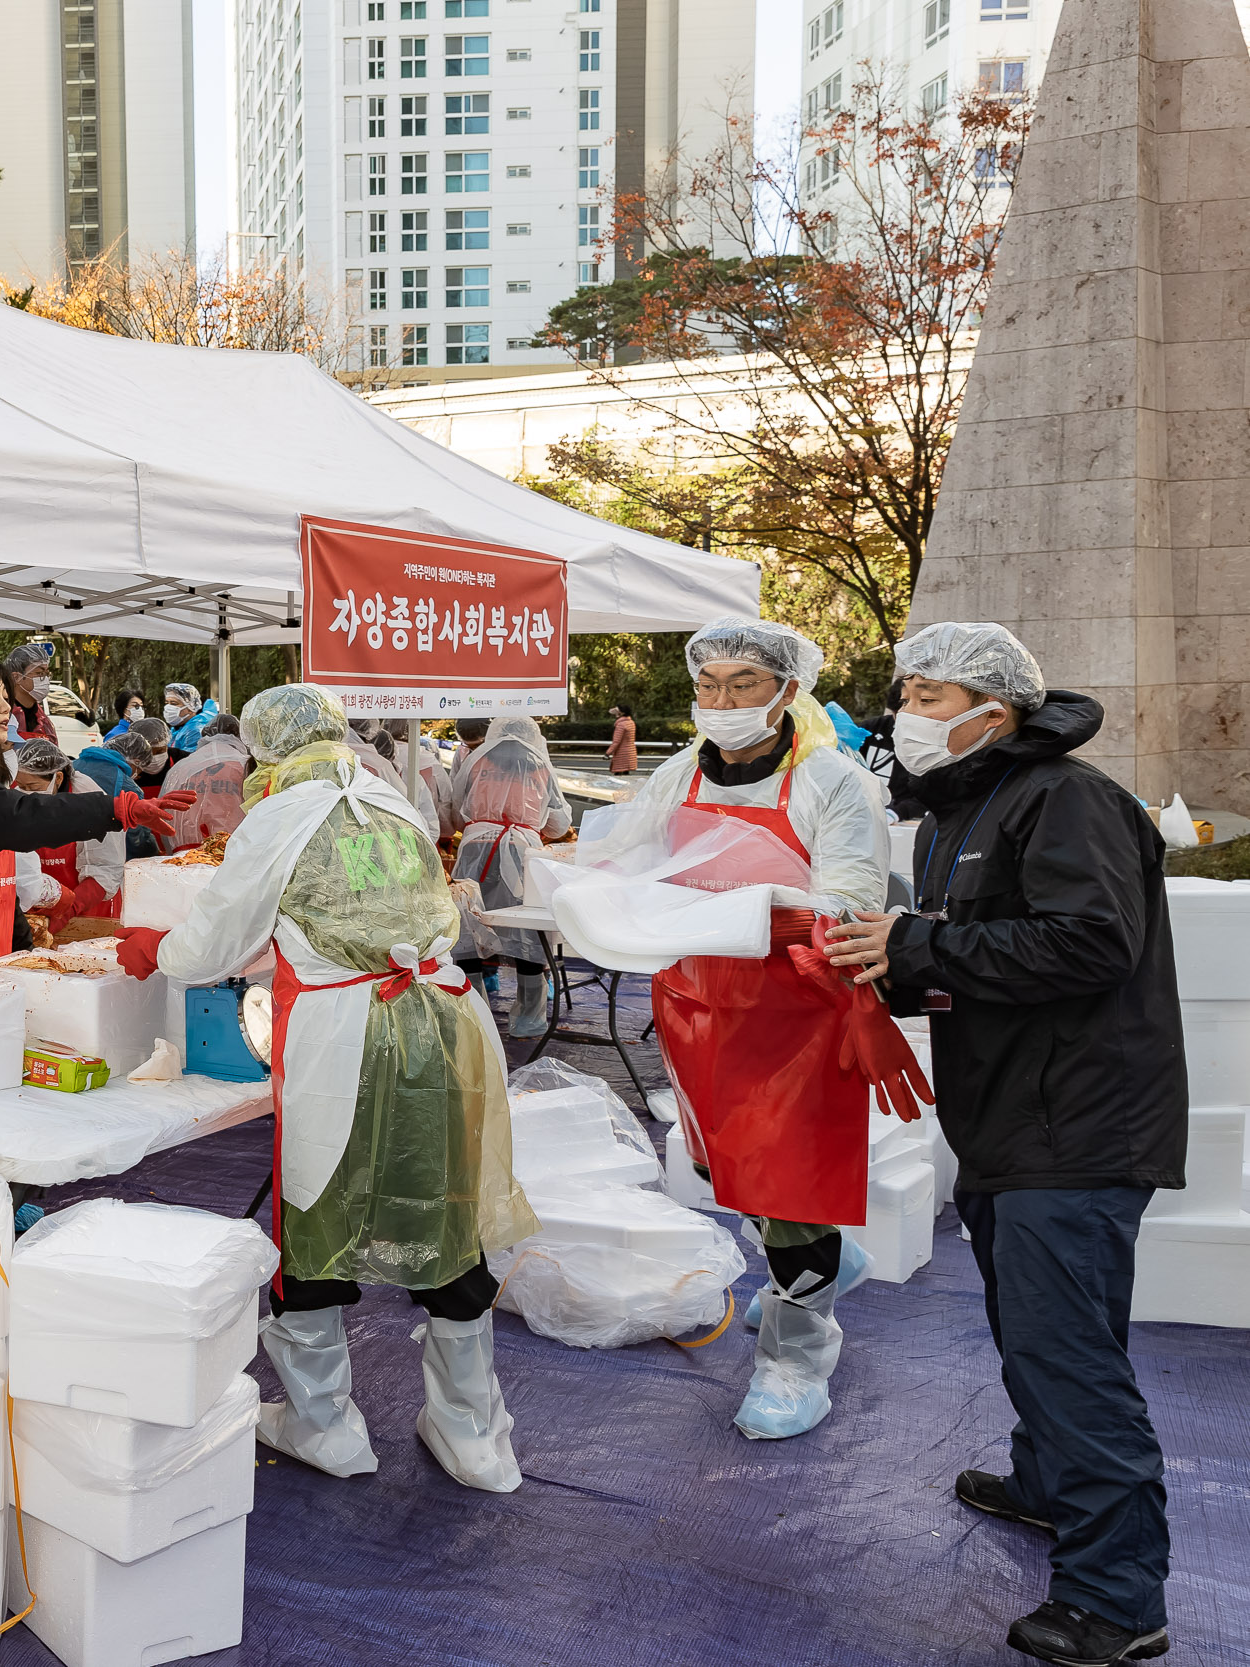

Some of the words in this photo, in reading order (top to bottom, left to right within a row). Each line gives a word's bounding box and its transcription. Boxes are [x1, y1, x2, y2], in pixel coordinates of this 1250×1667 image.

[403, 562, 438, 582] 지역주민이
[438, 567, 476, 586] 원(ONE)하는
[476, 571, 496, 588] 복지관
[328, 588, 555, 657] 자양종합사회복지관
[358, 694, 374, 709] 광진
[374, 694, 397, 709] 사랑의
[398, 694, 424, 710] 김장축제
[700, 879, 725, 890] 사랑의
